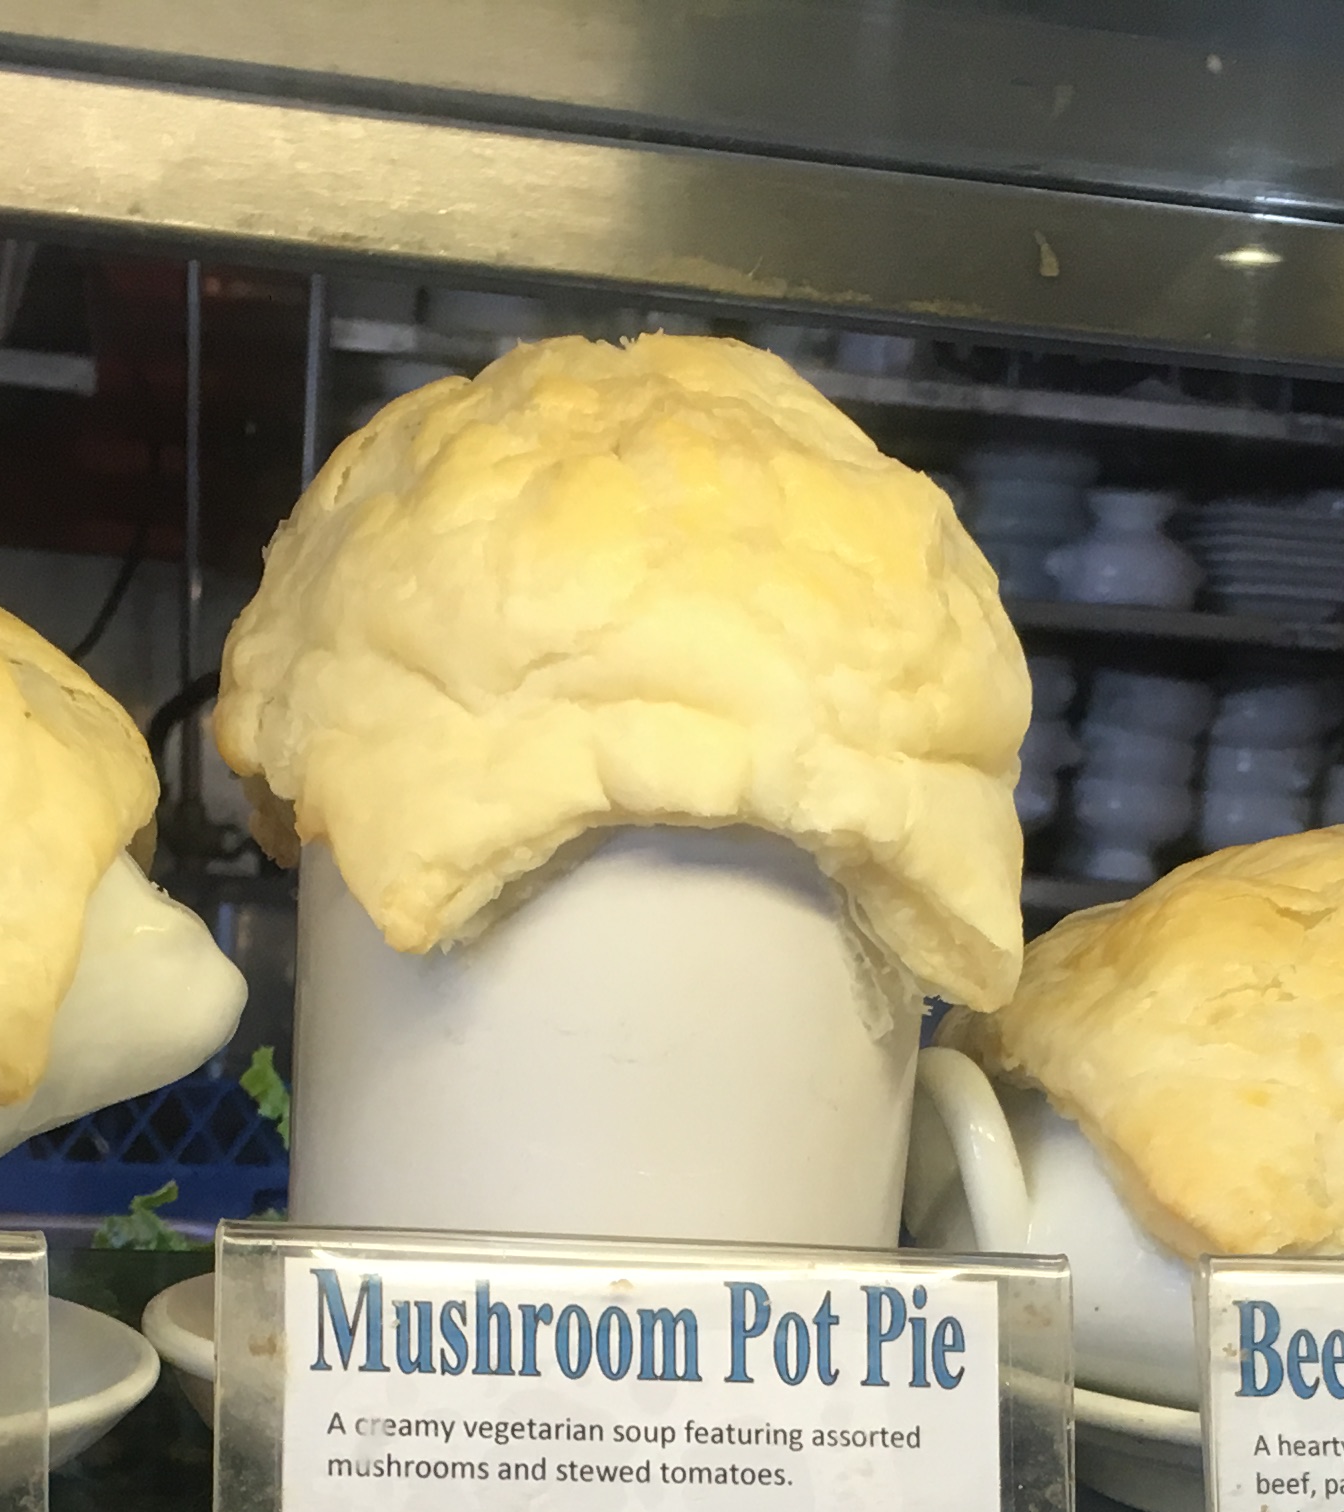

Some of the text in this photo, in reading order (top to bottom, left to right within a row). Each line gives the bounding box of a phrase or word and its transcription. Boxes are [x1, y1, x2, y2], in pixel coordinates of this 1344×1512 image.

[309, 1268, 966, 1390] Mushroom Pot Pie
[327, 1412, 921, 1451] A creamy vegetarian soup featuring assorted
[1253, 1434, 1271, 1457] A
[327, 1453, 794, 1486] mushrooms and stewed tomatoes.
[1256, 1472, 1317, 1499] beef,
